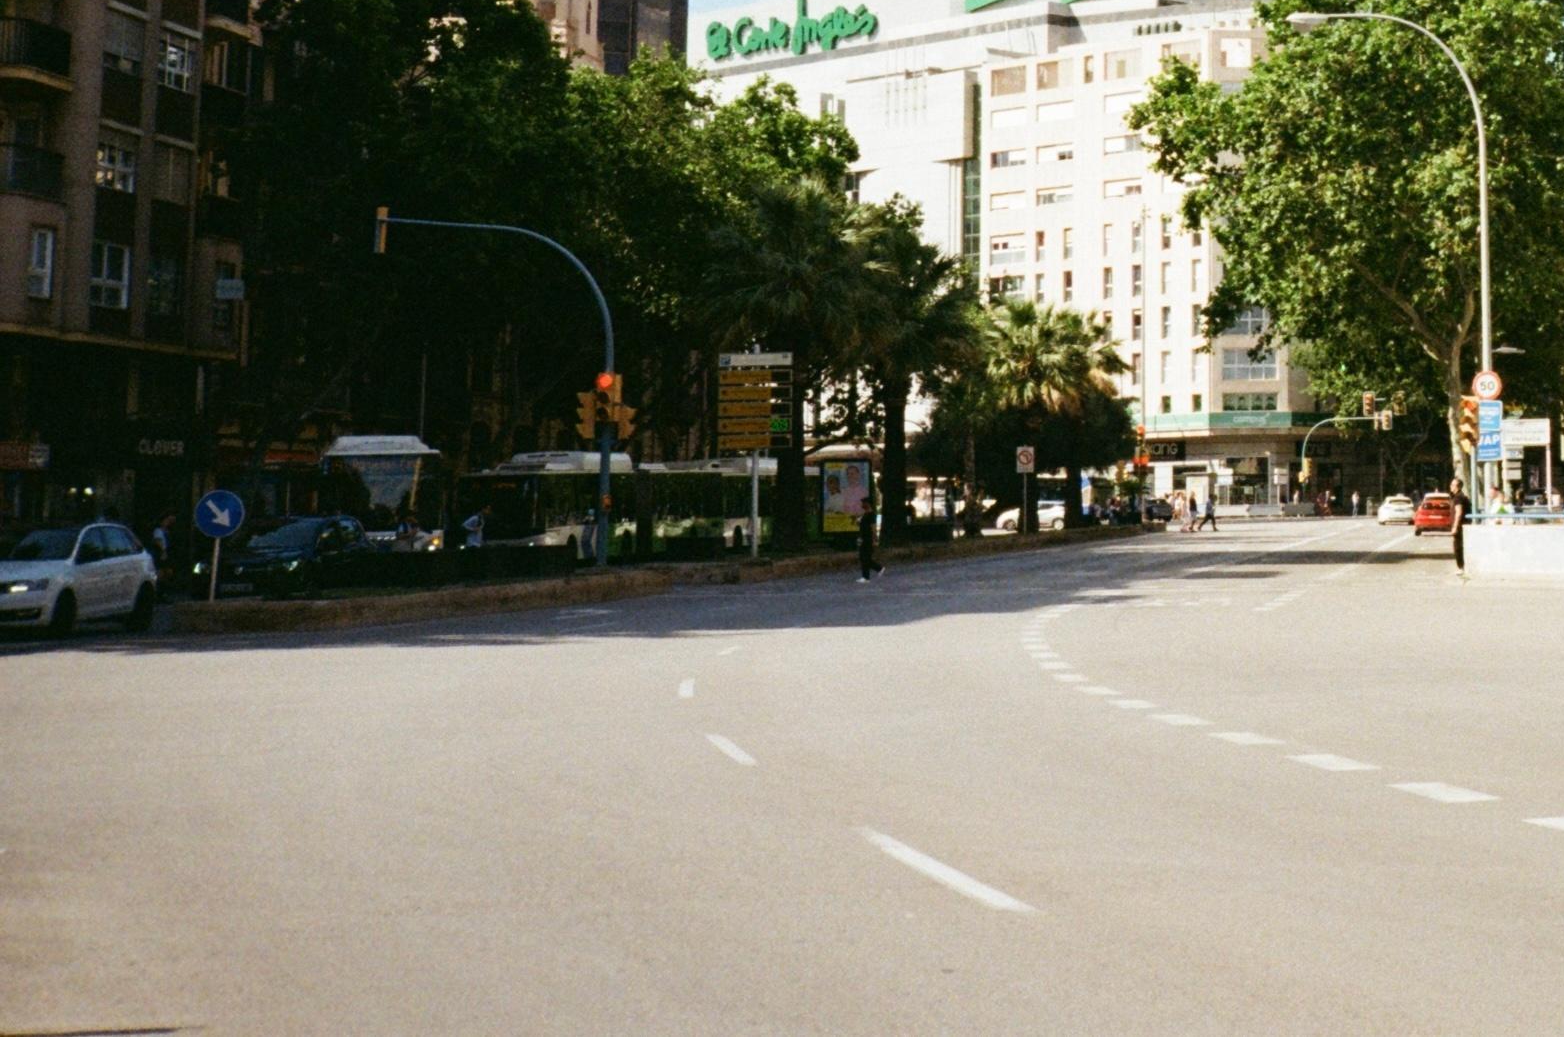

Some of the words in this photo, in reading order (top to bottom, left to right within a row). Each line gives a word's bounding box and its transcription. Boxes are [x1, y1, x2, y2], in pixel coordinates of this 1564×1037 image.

[706, 21, 732, 59] El
[732, 16, 790, 55] Corte
[1479, 381, 1496, 391] 50
